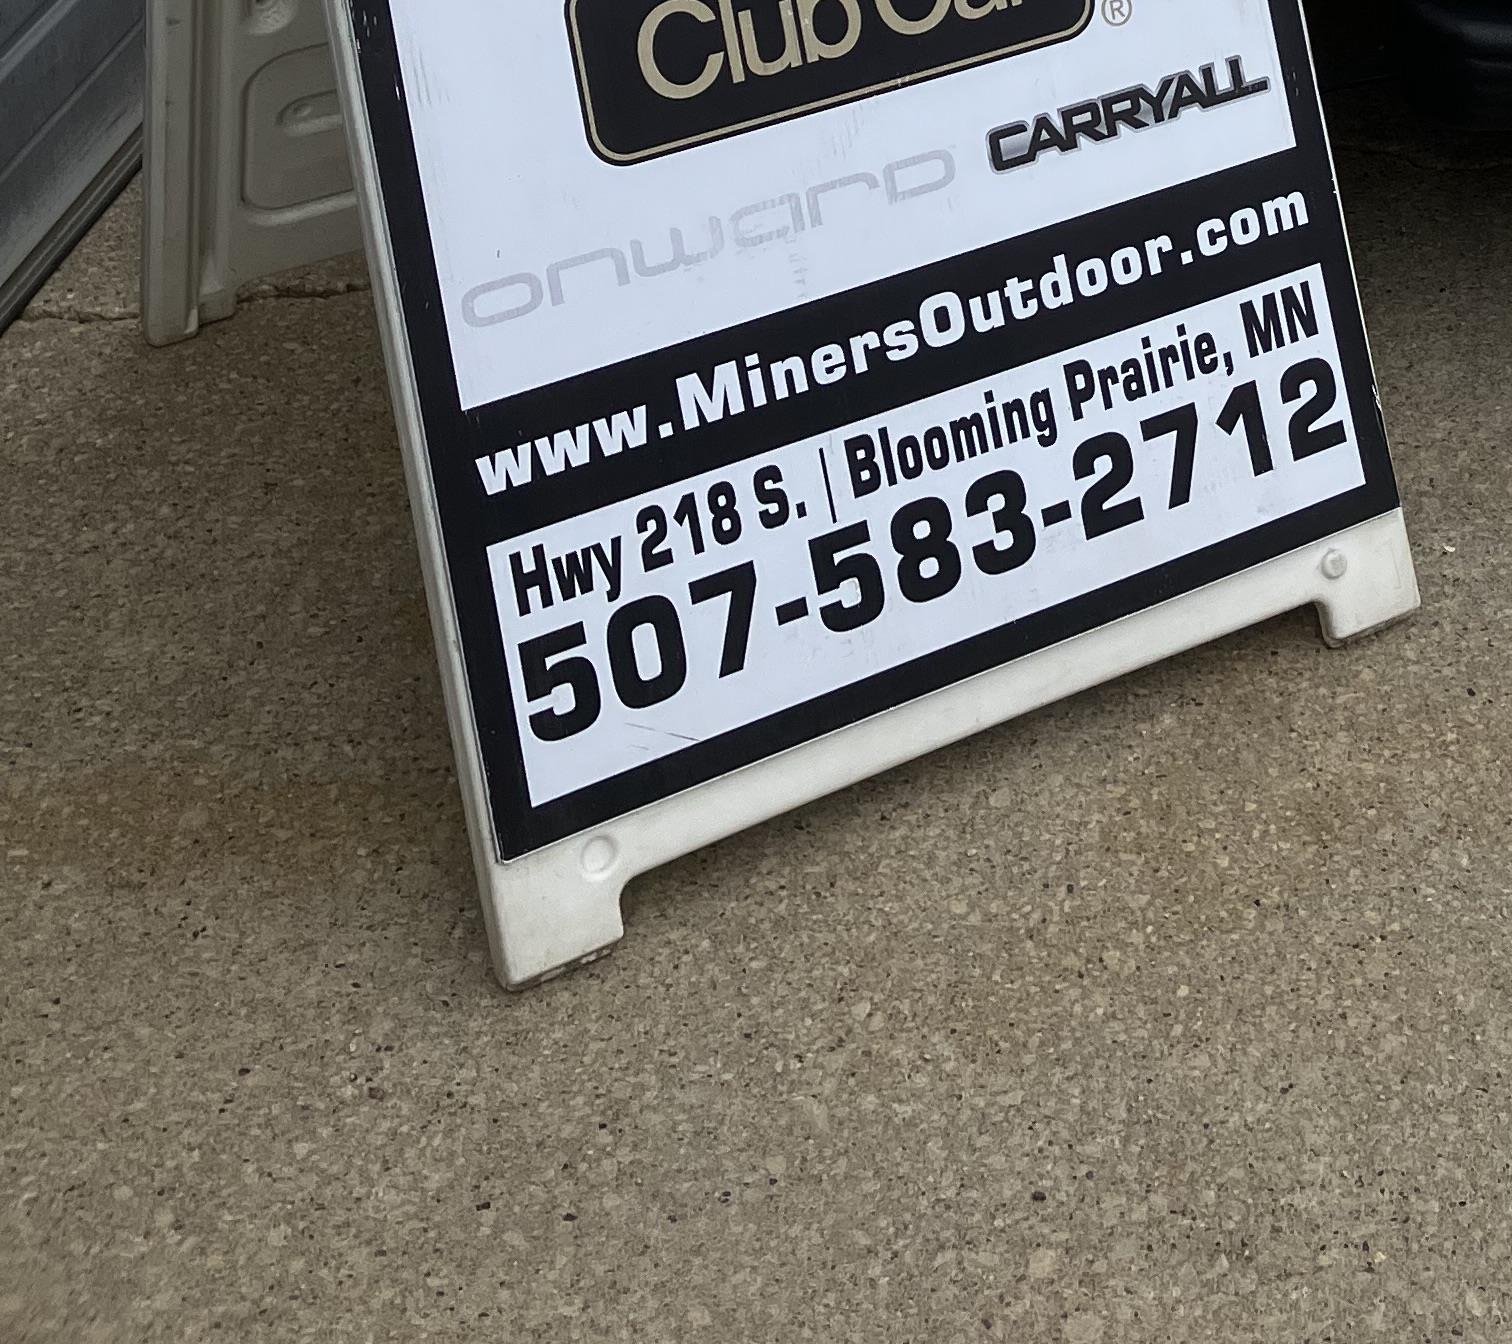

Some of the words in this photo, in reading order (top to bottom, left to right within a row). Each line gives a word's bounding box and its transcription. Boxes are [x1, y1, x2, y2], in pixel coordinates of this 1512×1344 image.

[986, 55, 1270, 174] CARRYALL
[475, 190, 1309, 496] www.MinersOutdoor.com
[509, 535, 622, 617] Hwy
[635, 481, 742, 573] 218
[753, 464, 807, 530] S.
[844, 387, 1057, 499] Blooming
[1064, 323, 1235, 421] Prairie,
[1239, 280, 1319, 358] MN
[517, 357, 1348, 742] 507-583-2712
